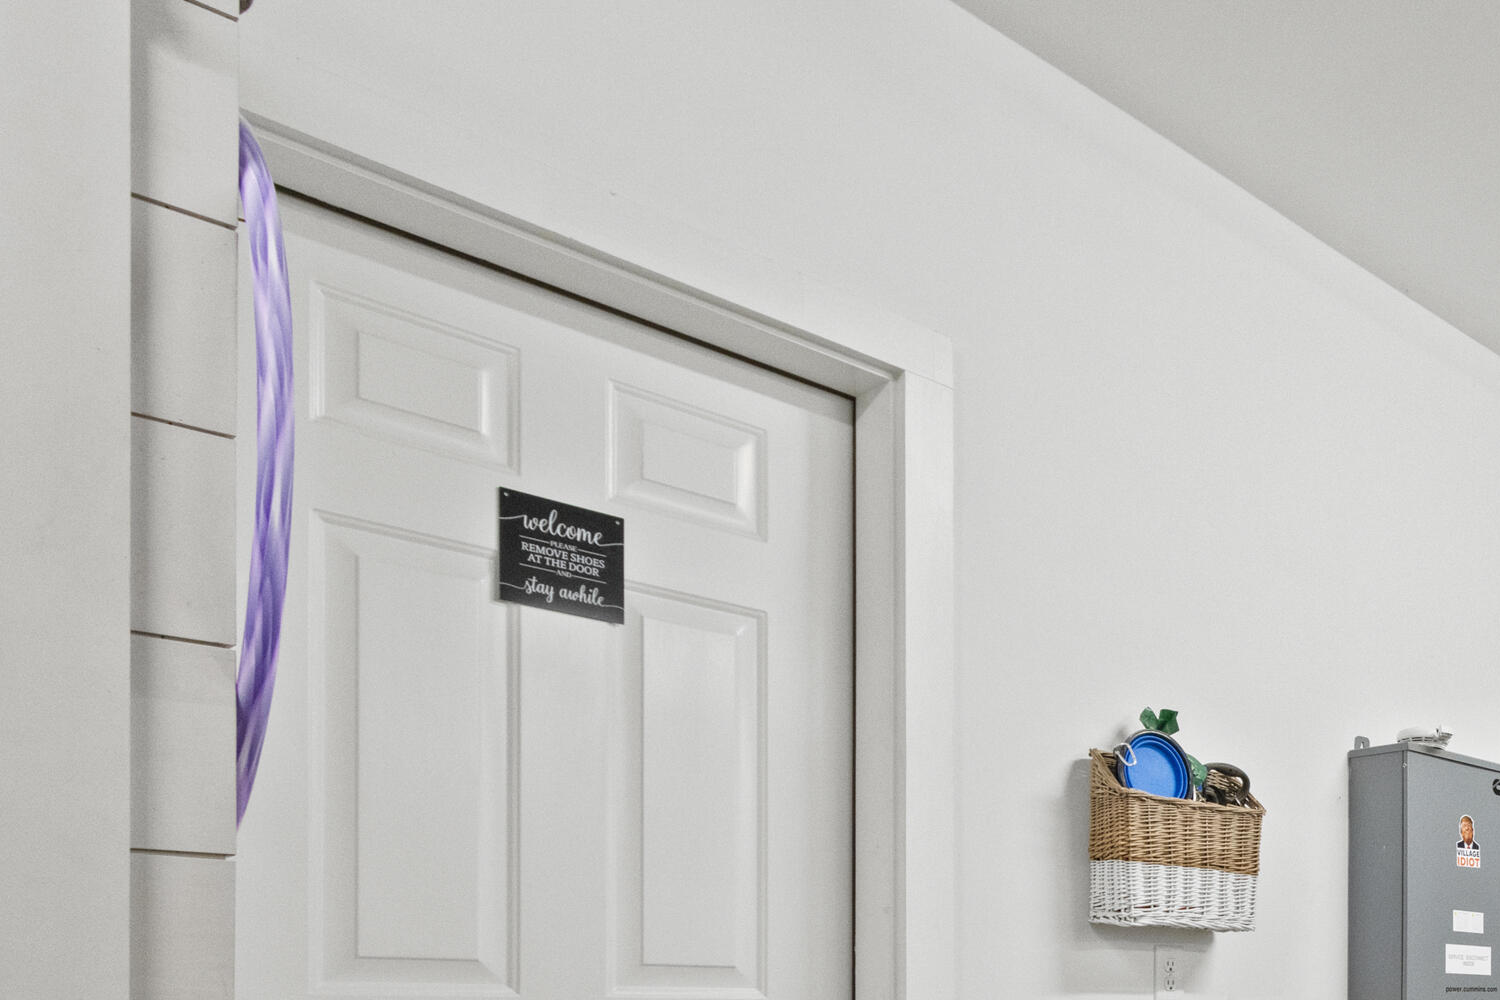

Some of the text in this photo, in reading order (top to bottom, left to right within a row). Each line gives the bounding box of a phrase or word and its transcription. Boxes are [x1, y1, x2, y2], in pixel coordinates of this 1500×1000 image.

[522, 509, 604, 546] welcome
[549, 540, 578, 551] PLEASE
[521, 541, 605, 569] REMOVE SHOES
[527, 553, 600, 577] AT THE DOOR
[556, 569, 572, 579] AND
[523, 576, 605, 607] stay awhile
[1457, 850, 1480, 858] VILLAGE
[1457, 856, 1480, 867] IDIOT
